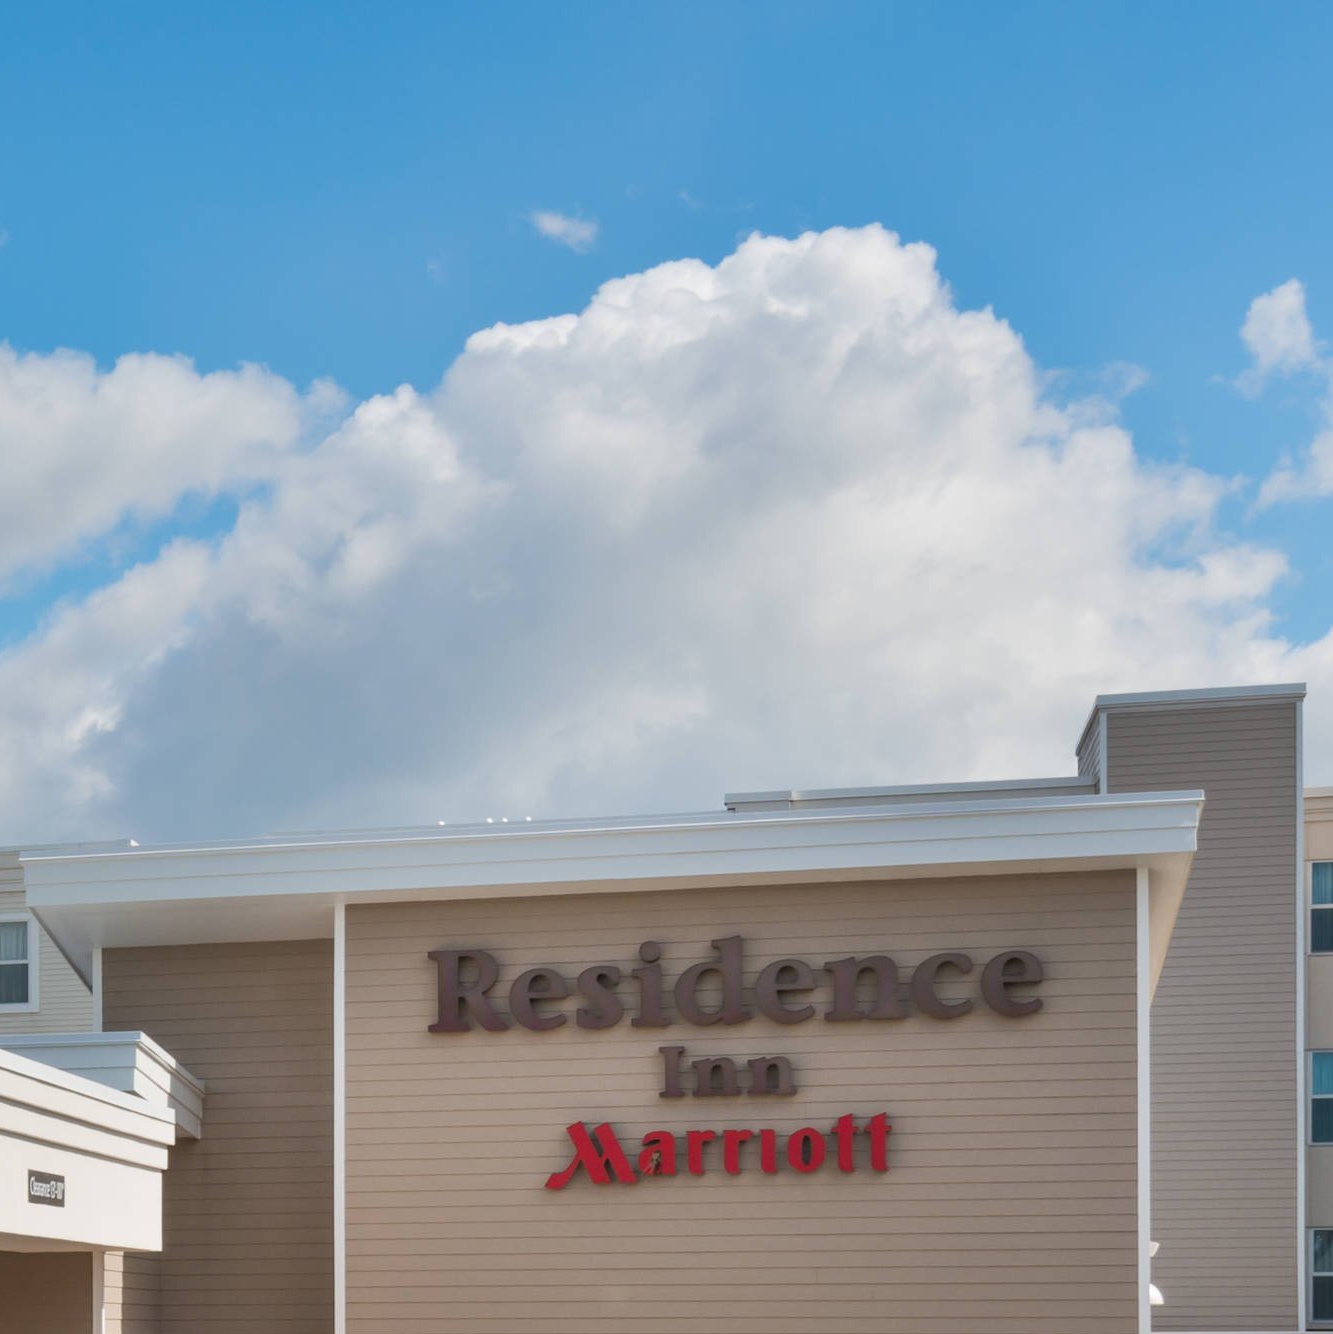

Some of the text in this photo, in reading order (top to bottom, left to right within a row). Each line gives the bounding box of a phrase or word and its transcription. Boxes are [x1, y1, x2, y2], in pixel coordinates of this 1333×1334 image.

[427, 935, 1046, 1033] Residence
[658, 1045, 798, 1098] Inn
[544, 1112, 892, 1190] Marriott
